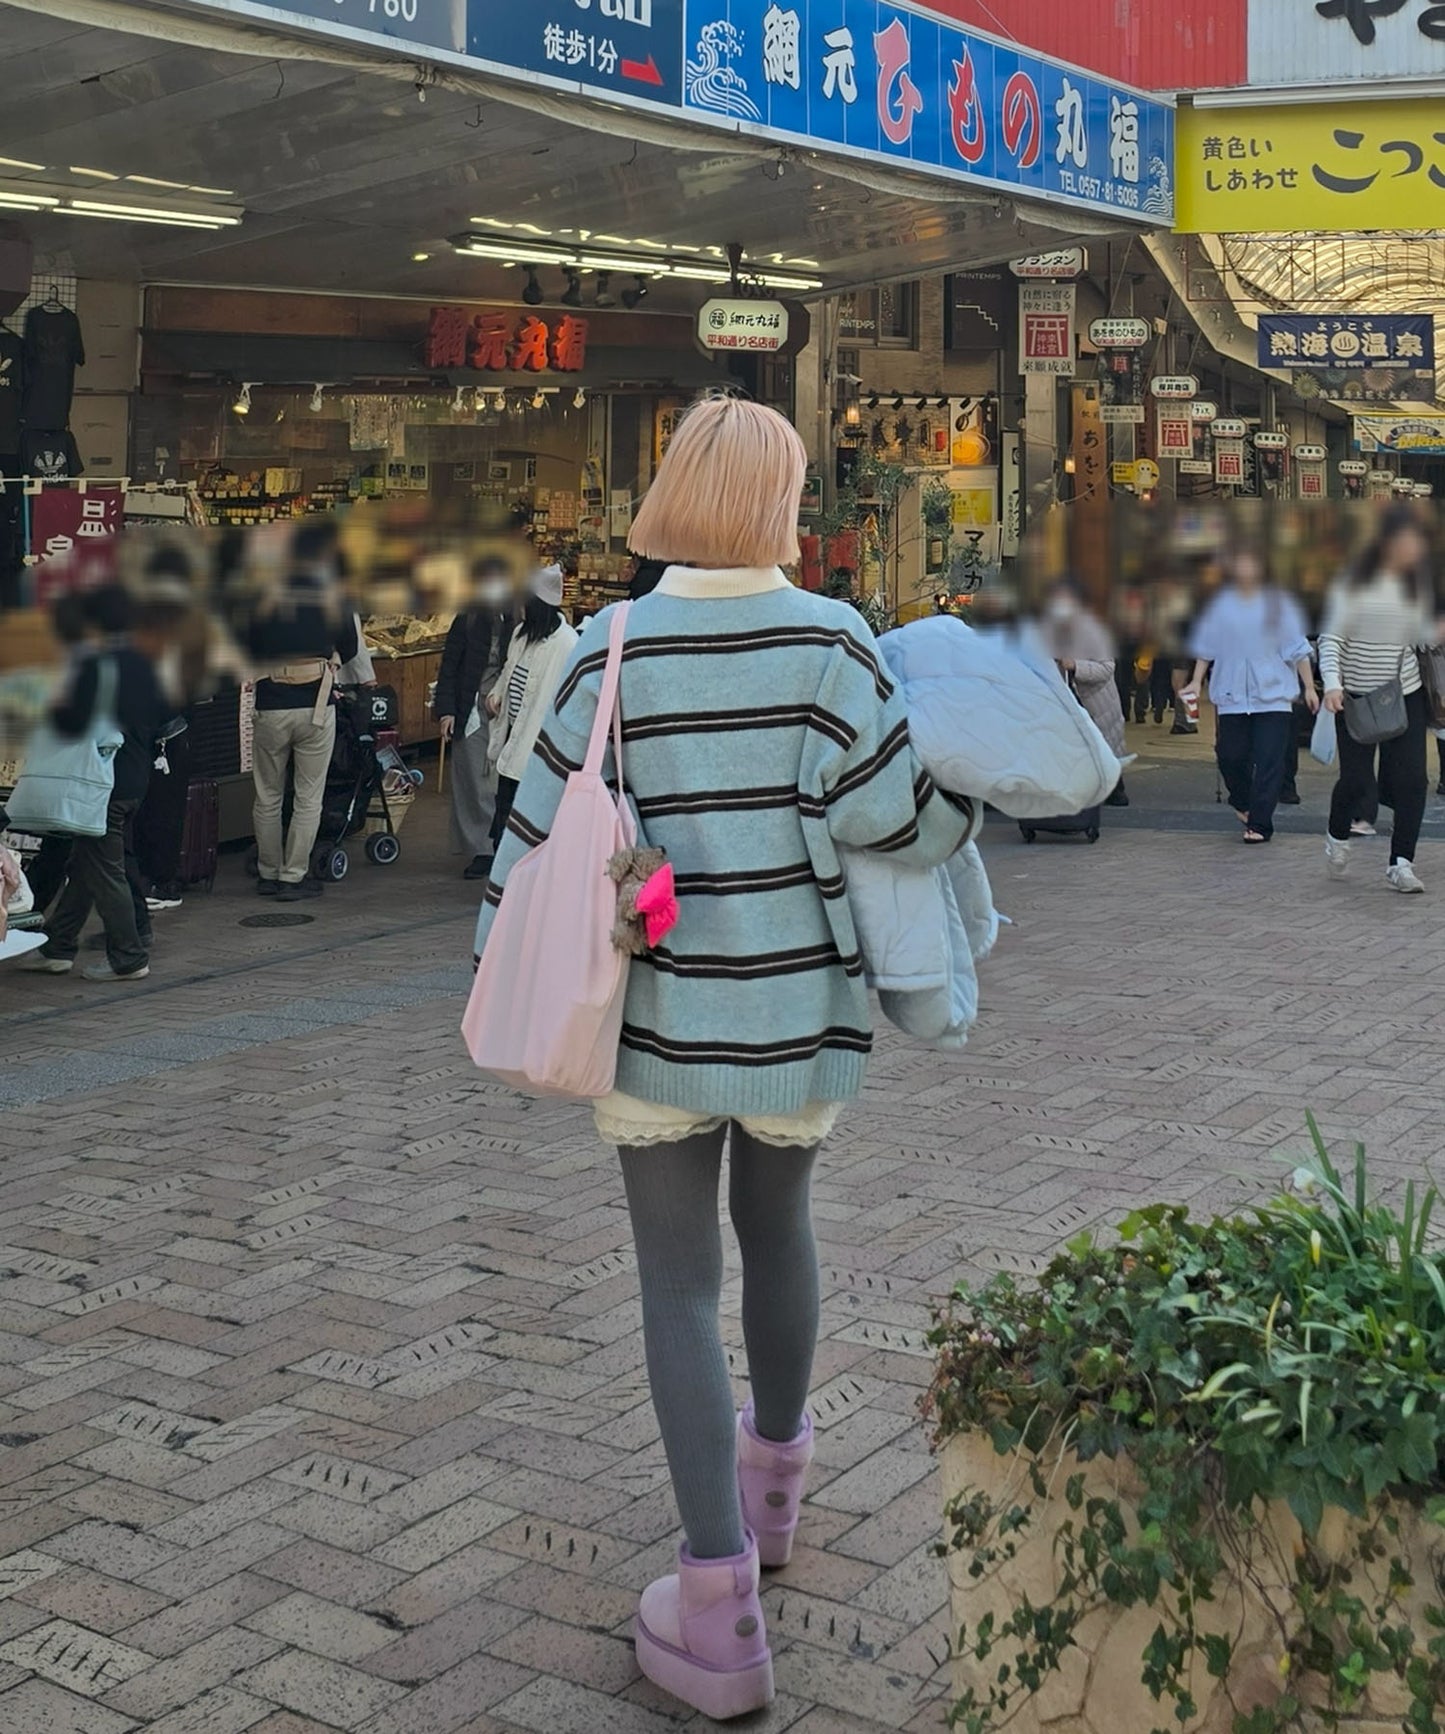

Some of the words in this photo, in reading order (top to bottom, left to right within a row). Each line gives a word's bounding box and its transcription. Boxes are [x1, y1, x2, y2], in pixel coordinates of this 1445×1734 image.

[543, 22, 618, 74] 徒歩1分
[1202, 136, 1273, 160] 黄色い
[1206, 168, 1298, 191] しあわせ
[1317, 321, 1373, 331] ようこそ
[707, 334, 779, 349] 平和通り名店街
[1270, 331, 1329, 357] 熱海
[1361, 332, 1423, 357] 温泉
